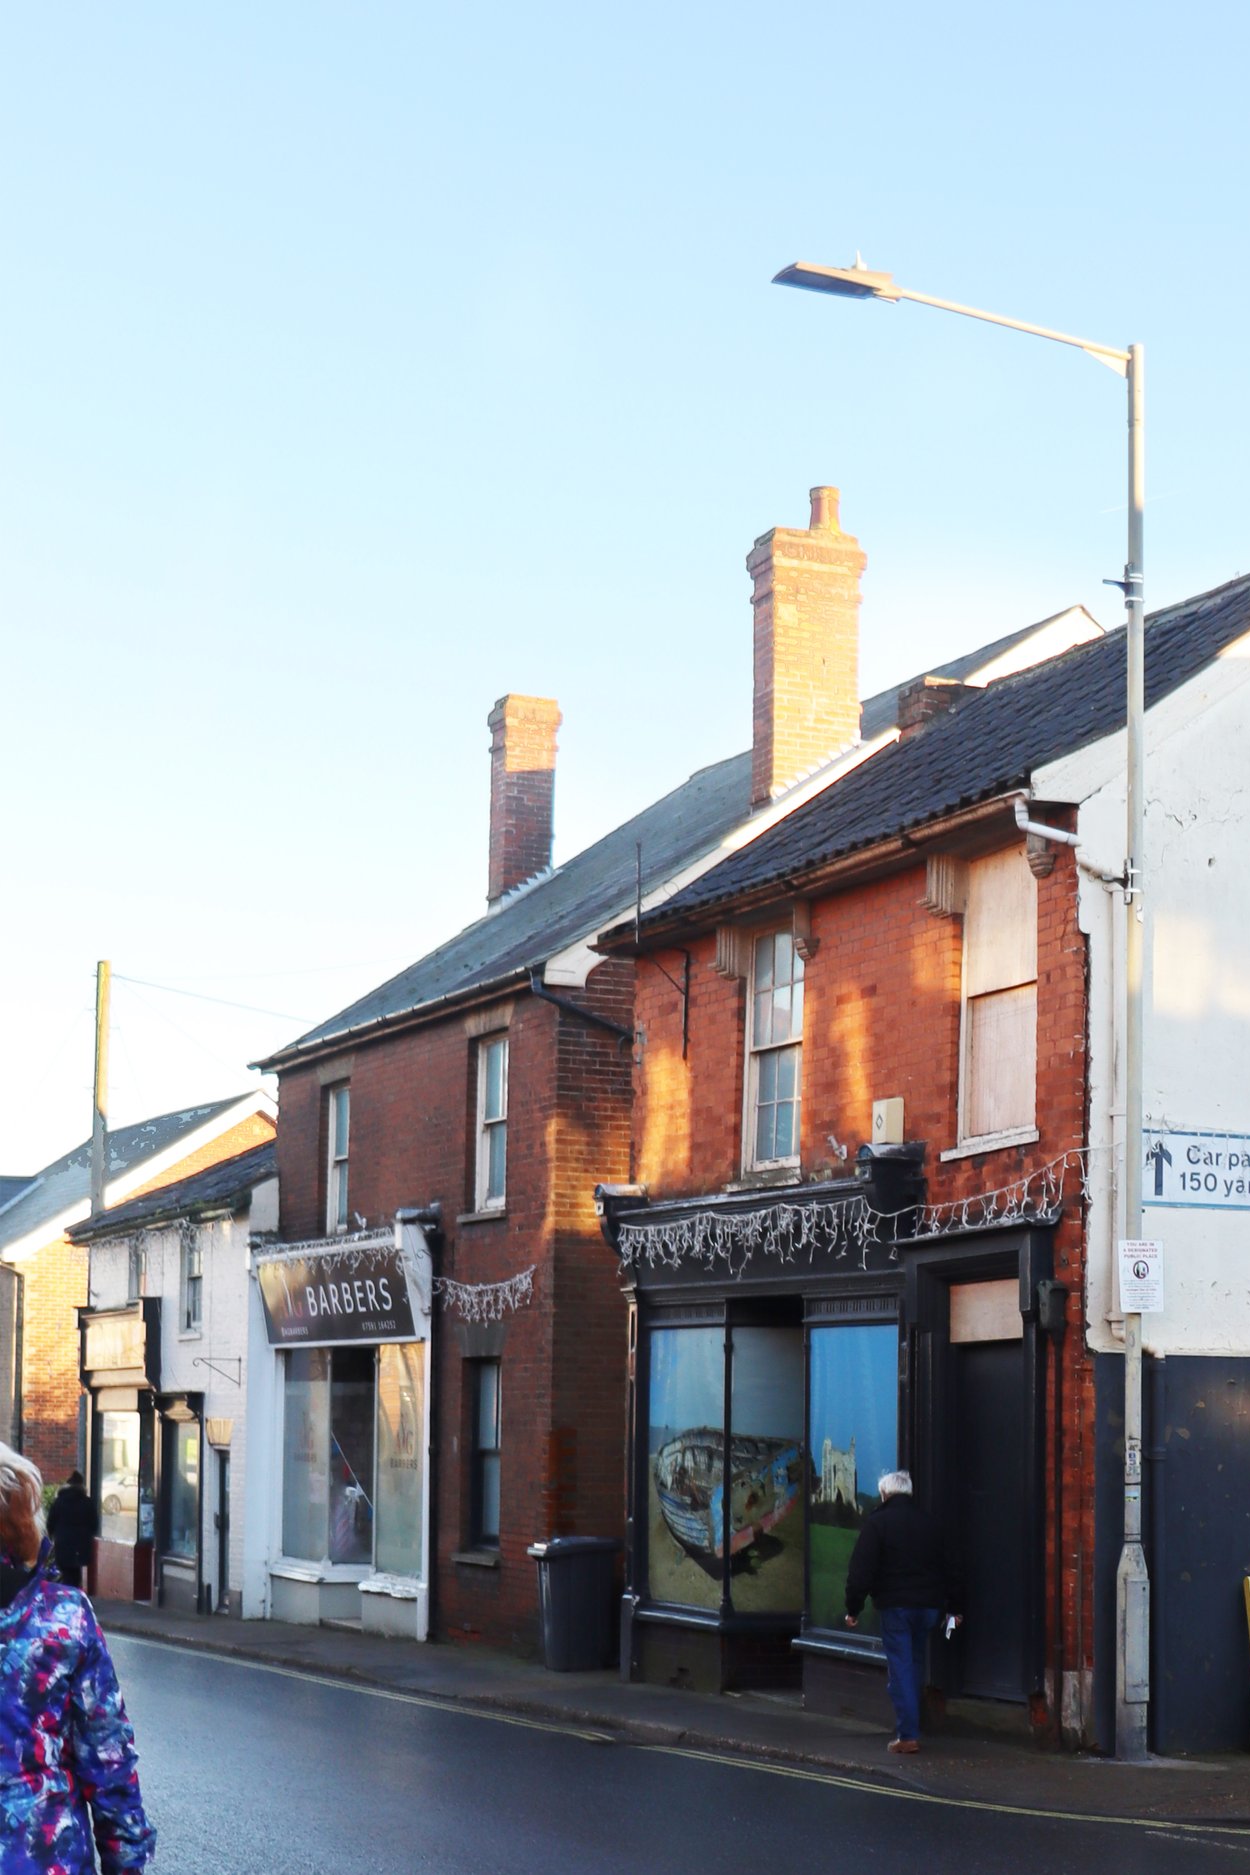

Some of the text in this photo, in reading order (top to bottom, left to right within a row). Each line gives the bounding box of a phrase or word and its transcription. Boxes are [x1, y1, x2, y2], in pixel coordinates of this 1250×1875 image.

[1186, 1144, 1222, 1166] Car
[1179, 1171, 1218, 1192] 150
[305, 1277, 393, 1317] BARBERS
